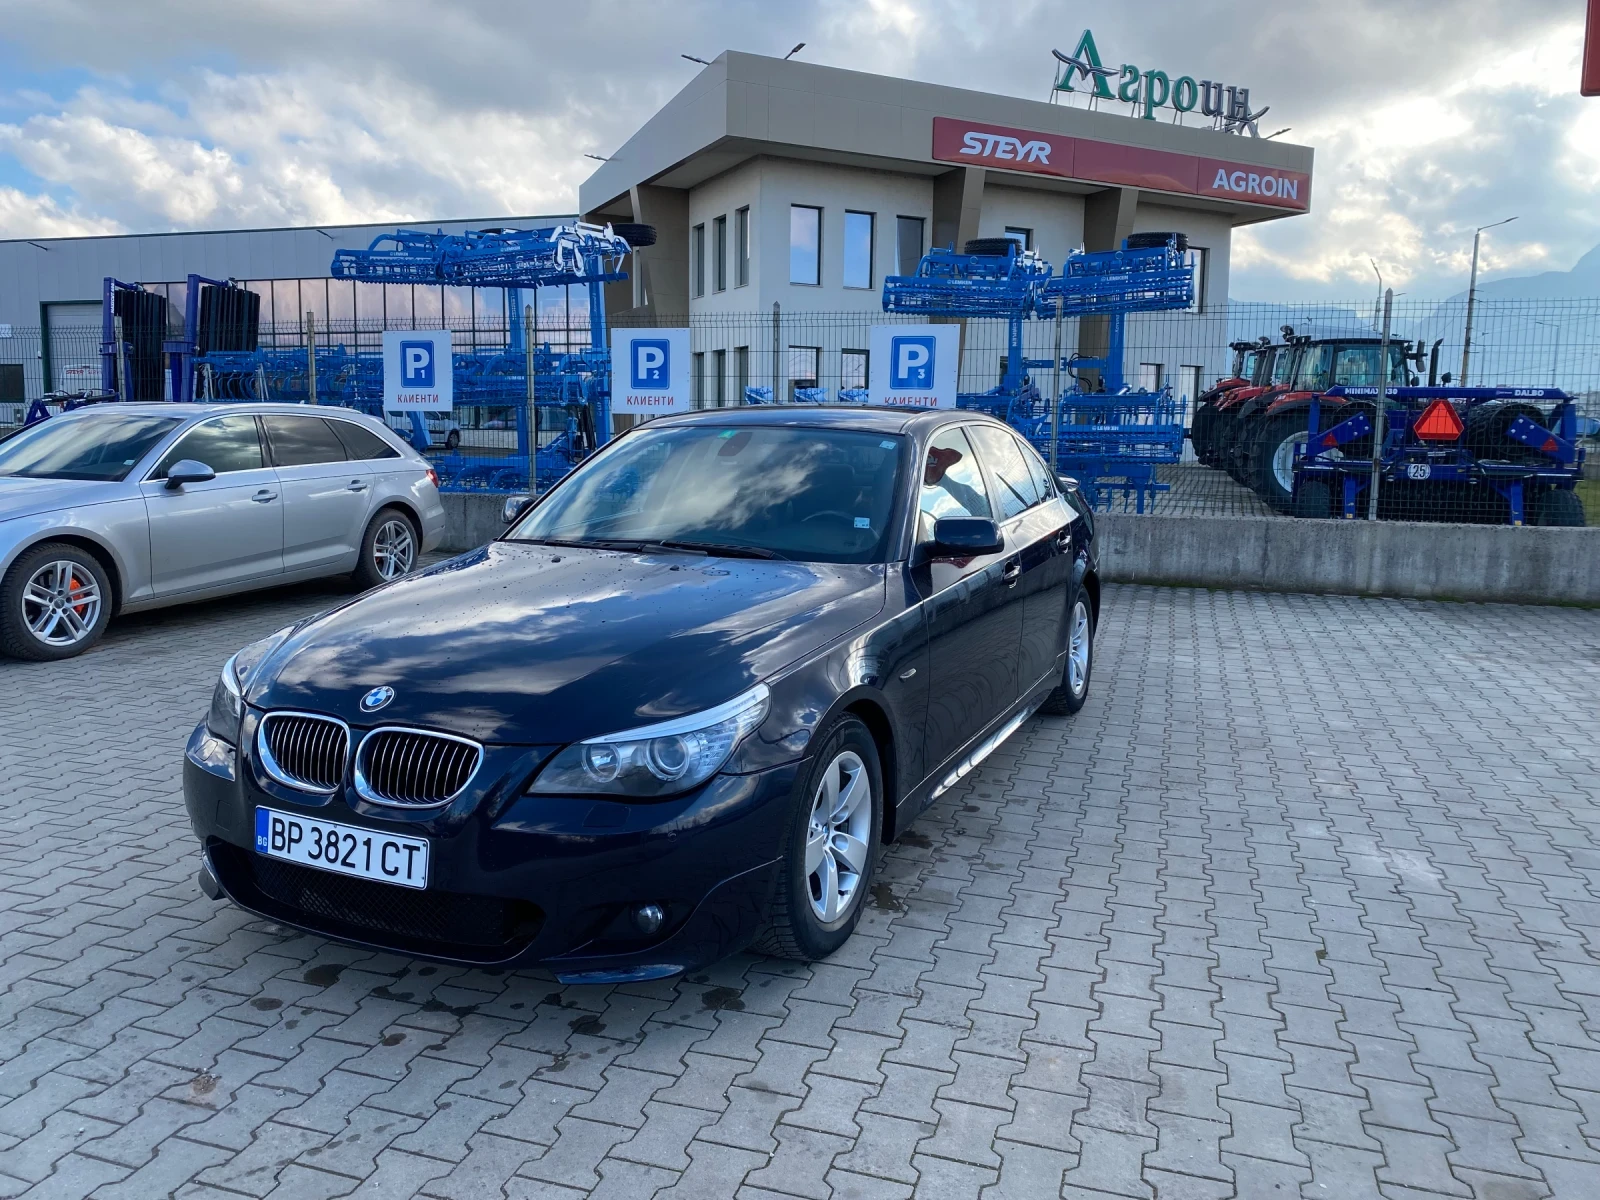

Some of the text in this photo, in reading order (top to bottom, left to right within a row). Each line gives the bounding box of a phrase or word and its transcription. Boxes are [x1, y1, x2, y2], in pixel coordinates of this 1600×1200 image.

[1052, 28, 1251, 122] Агроин
[959, 131, 1052, 165] STEYR
[1212, 168, 1298, 200] AGROIN
[397, 394, 439, 404] КЛИЕНТИ
[626, 395, 674, 406] КЛИЕНТИ
[1413, 465, 1426, 478] 25
[257, 835, 268, 847] BG
[271, 816, 421, 880] BP 3821 CT
